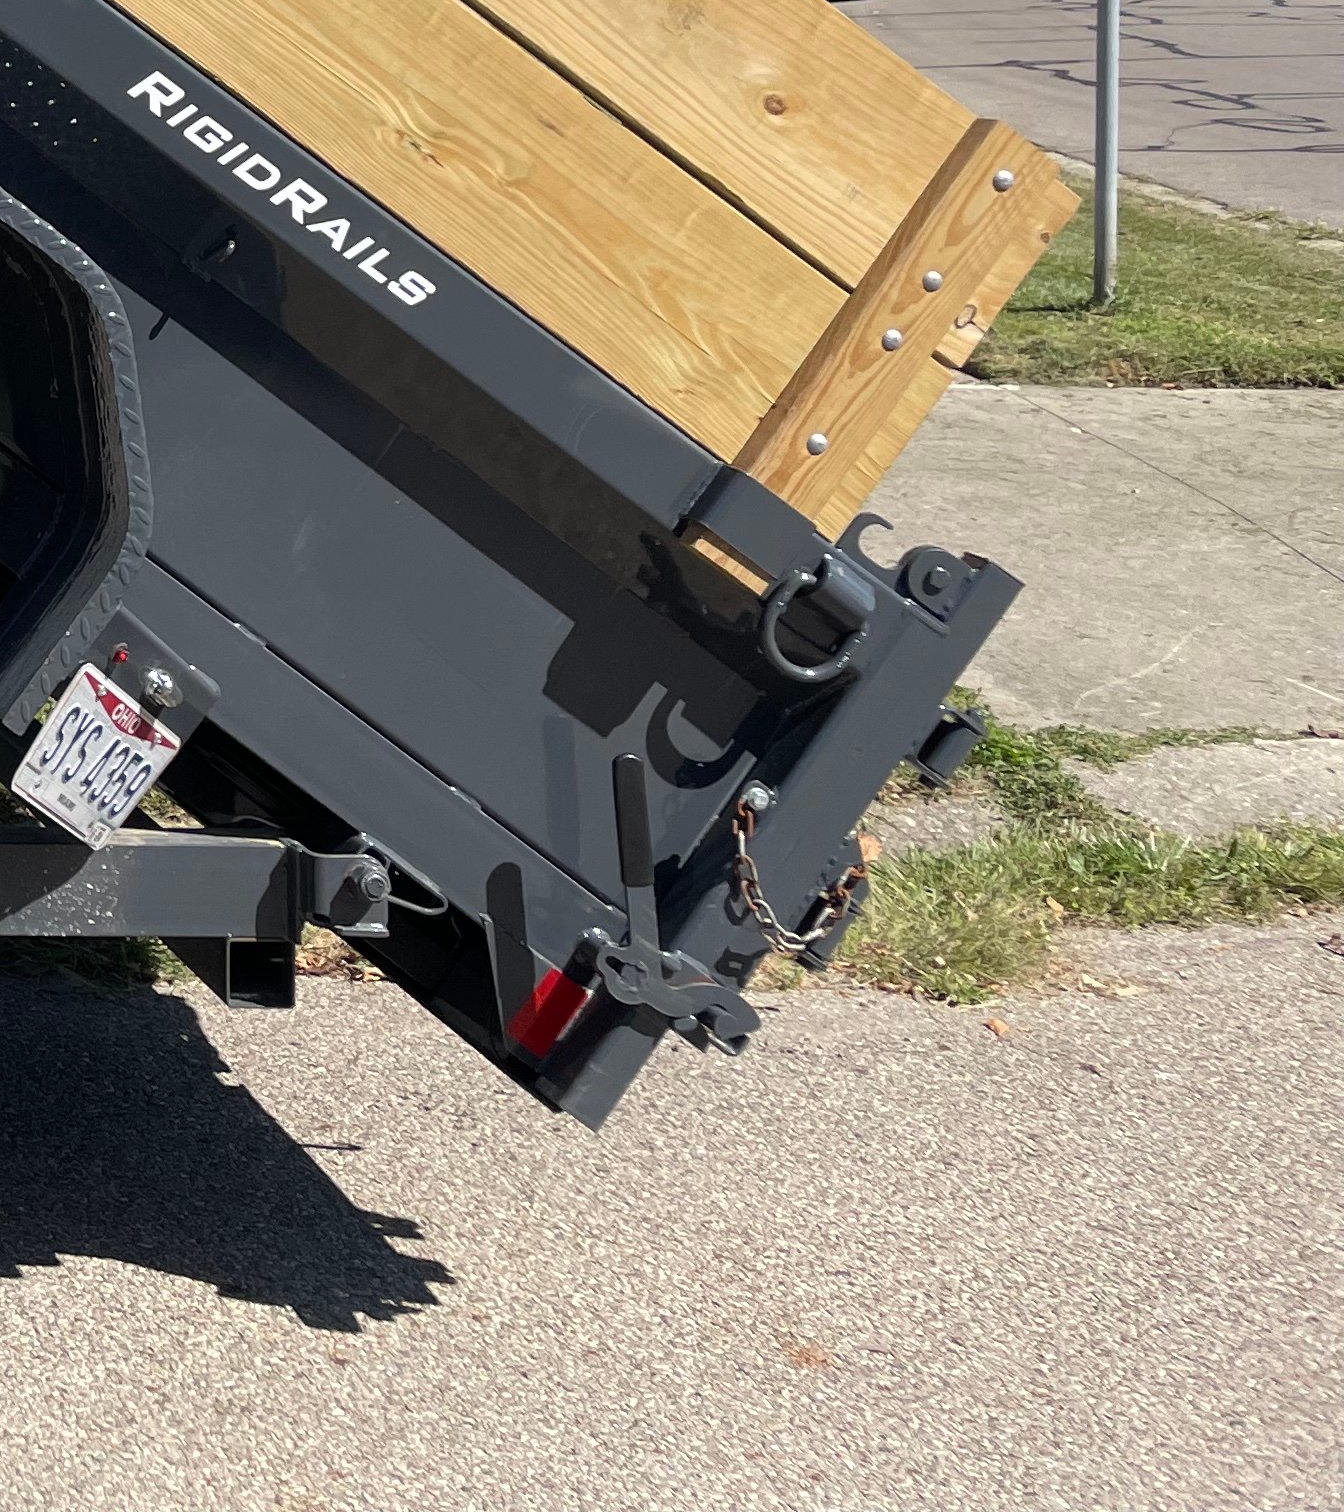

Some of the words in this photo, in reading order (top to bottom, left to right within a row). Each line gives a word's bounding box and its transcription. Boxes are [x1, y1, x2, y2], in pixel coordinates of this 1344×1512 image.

[126, 70, 437, 306] RIGIDRAILS
[40, 703, 103, 784] SYS
[79, 734, 152, 820] 4359
[111, 703, 143, 734] OHIO
